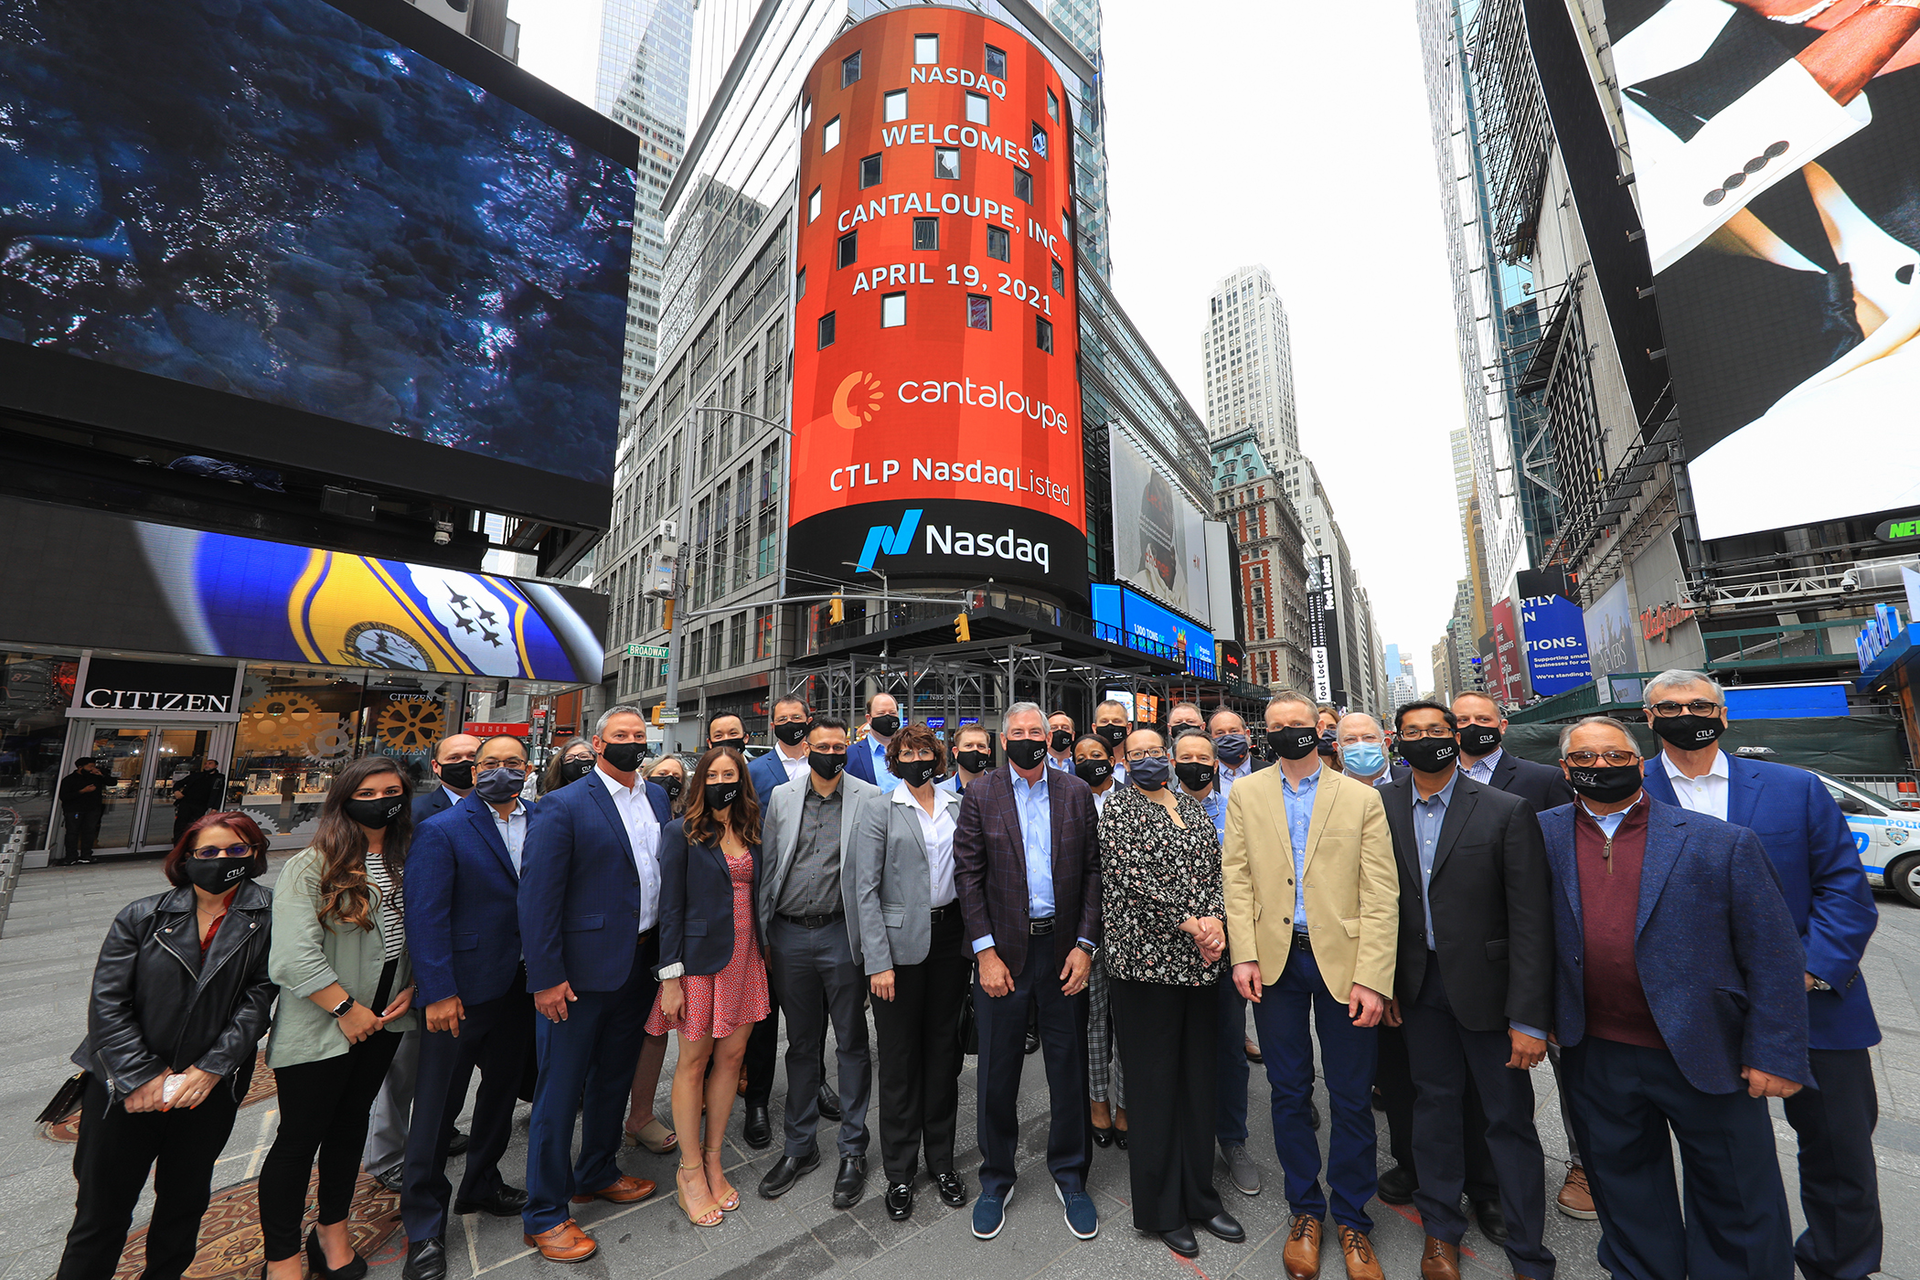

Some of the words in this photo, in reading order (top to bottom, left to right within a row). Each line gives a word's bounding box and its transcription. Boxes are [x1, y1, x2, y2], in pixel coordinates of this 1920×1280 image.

[910, 66, 1007, 101] NASDAQ
[881, 123, 1031, 170] WELCOMES
[837, 191, 1021, 235] CANTALOUPE,
[1027, 217, 1062, 261] INC.
[852, 262, 935, 296] APRIL
[946, 263, 988, 292] 19,
[997, 272, 1052, 317] 2021
[897, 376, 1069, 435] cantaloupe
[829, 459, 900, 492] CTLP
[925, 524, 1050, 574] Nasdaq
[629, 645, 667, 657] BROADWAY
[1534, 655, 1569, 663] Supporting
[1316, 650, 1325, 679] Locker
[1555, 671, 1584, 679] standing
[85, 688, 230, 712] CITIZEN
[930, 693, 957, 701] Nasaq
[1318, 681, 1327, 701] Foot
[1298, 735, 1312, 744] CTLP
[1479, 734, 1493, 742] CTLP
[1696, 729, 1714, 738] CTLP
[1436, 746, 1452, 757] CTLP
[226, 866, 245, 878] CTLP
